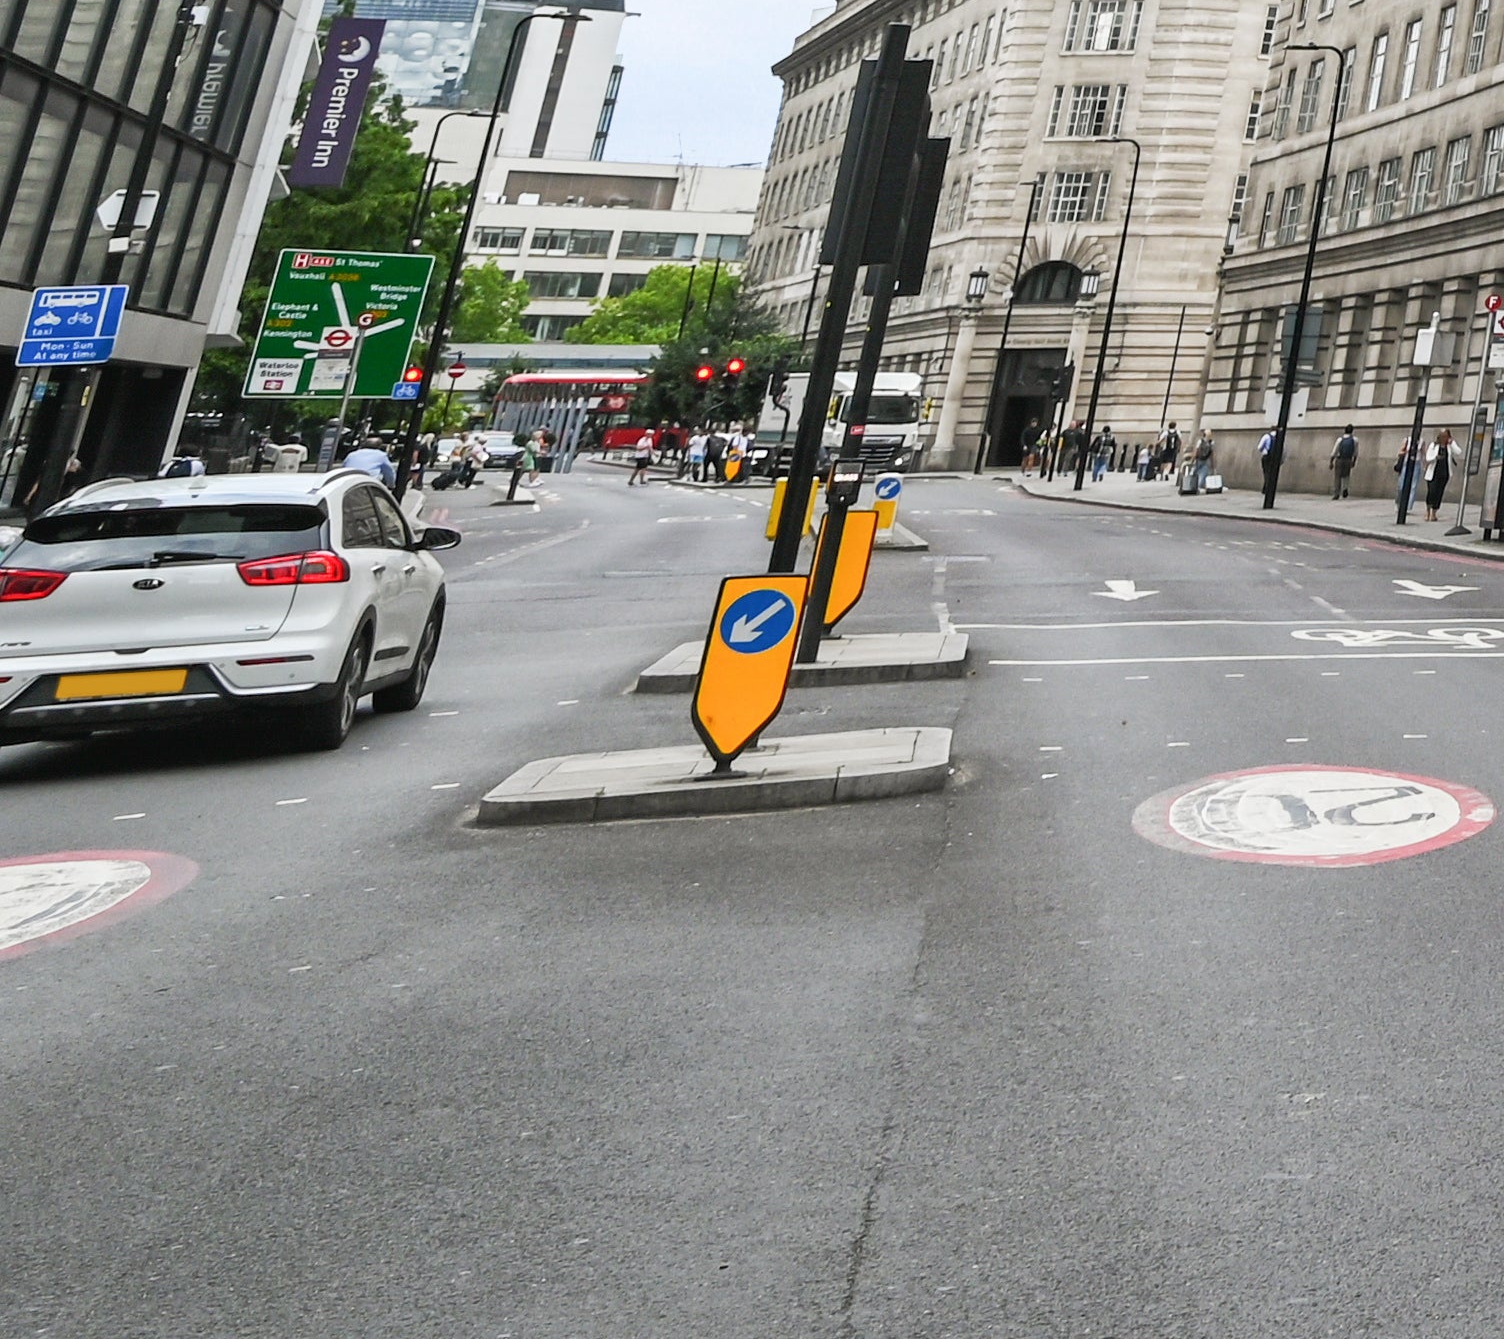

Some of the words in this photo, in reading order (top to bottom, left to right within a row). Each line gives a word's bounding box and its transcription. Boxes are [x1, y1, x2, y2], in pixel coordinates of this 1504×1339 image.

[320, 67, 359, 137] Premier
[312, 140, 339, 168] Inn
[289, 272, 326, 280] Vauxhall
[371, 284, 422, 293] Westminster
[380, 292, 408, 301] Bridge
[271, 302, 309, 311] Elephant
[365, 302, 398, 311] Victoria
[1488, 296, 1499, 309] F
[278, 311, 307, 319] Castle
[358, 313, 373, 323] G
[32, 327, 52, 336] taxi
[263, 330, 312, 338] Kennington
[41, 342, 65, 351] Mon
[73, 341, 94, 350] Sun
[33, 352, 46, 360] At
[49, 352, 69, 361] any
[72, 351, 97, 359] time
[259, 361, 299, 370] Waterloo
[260, 370, 293, 378] Station
